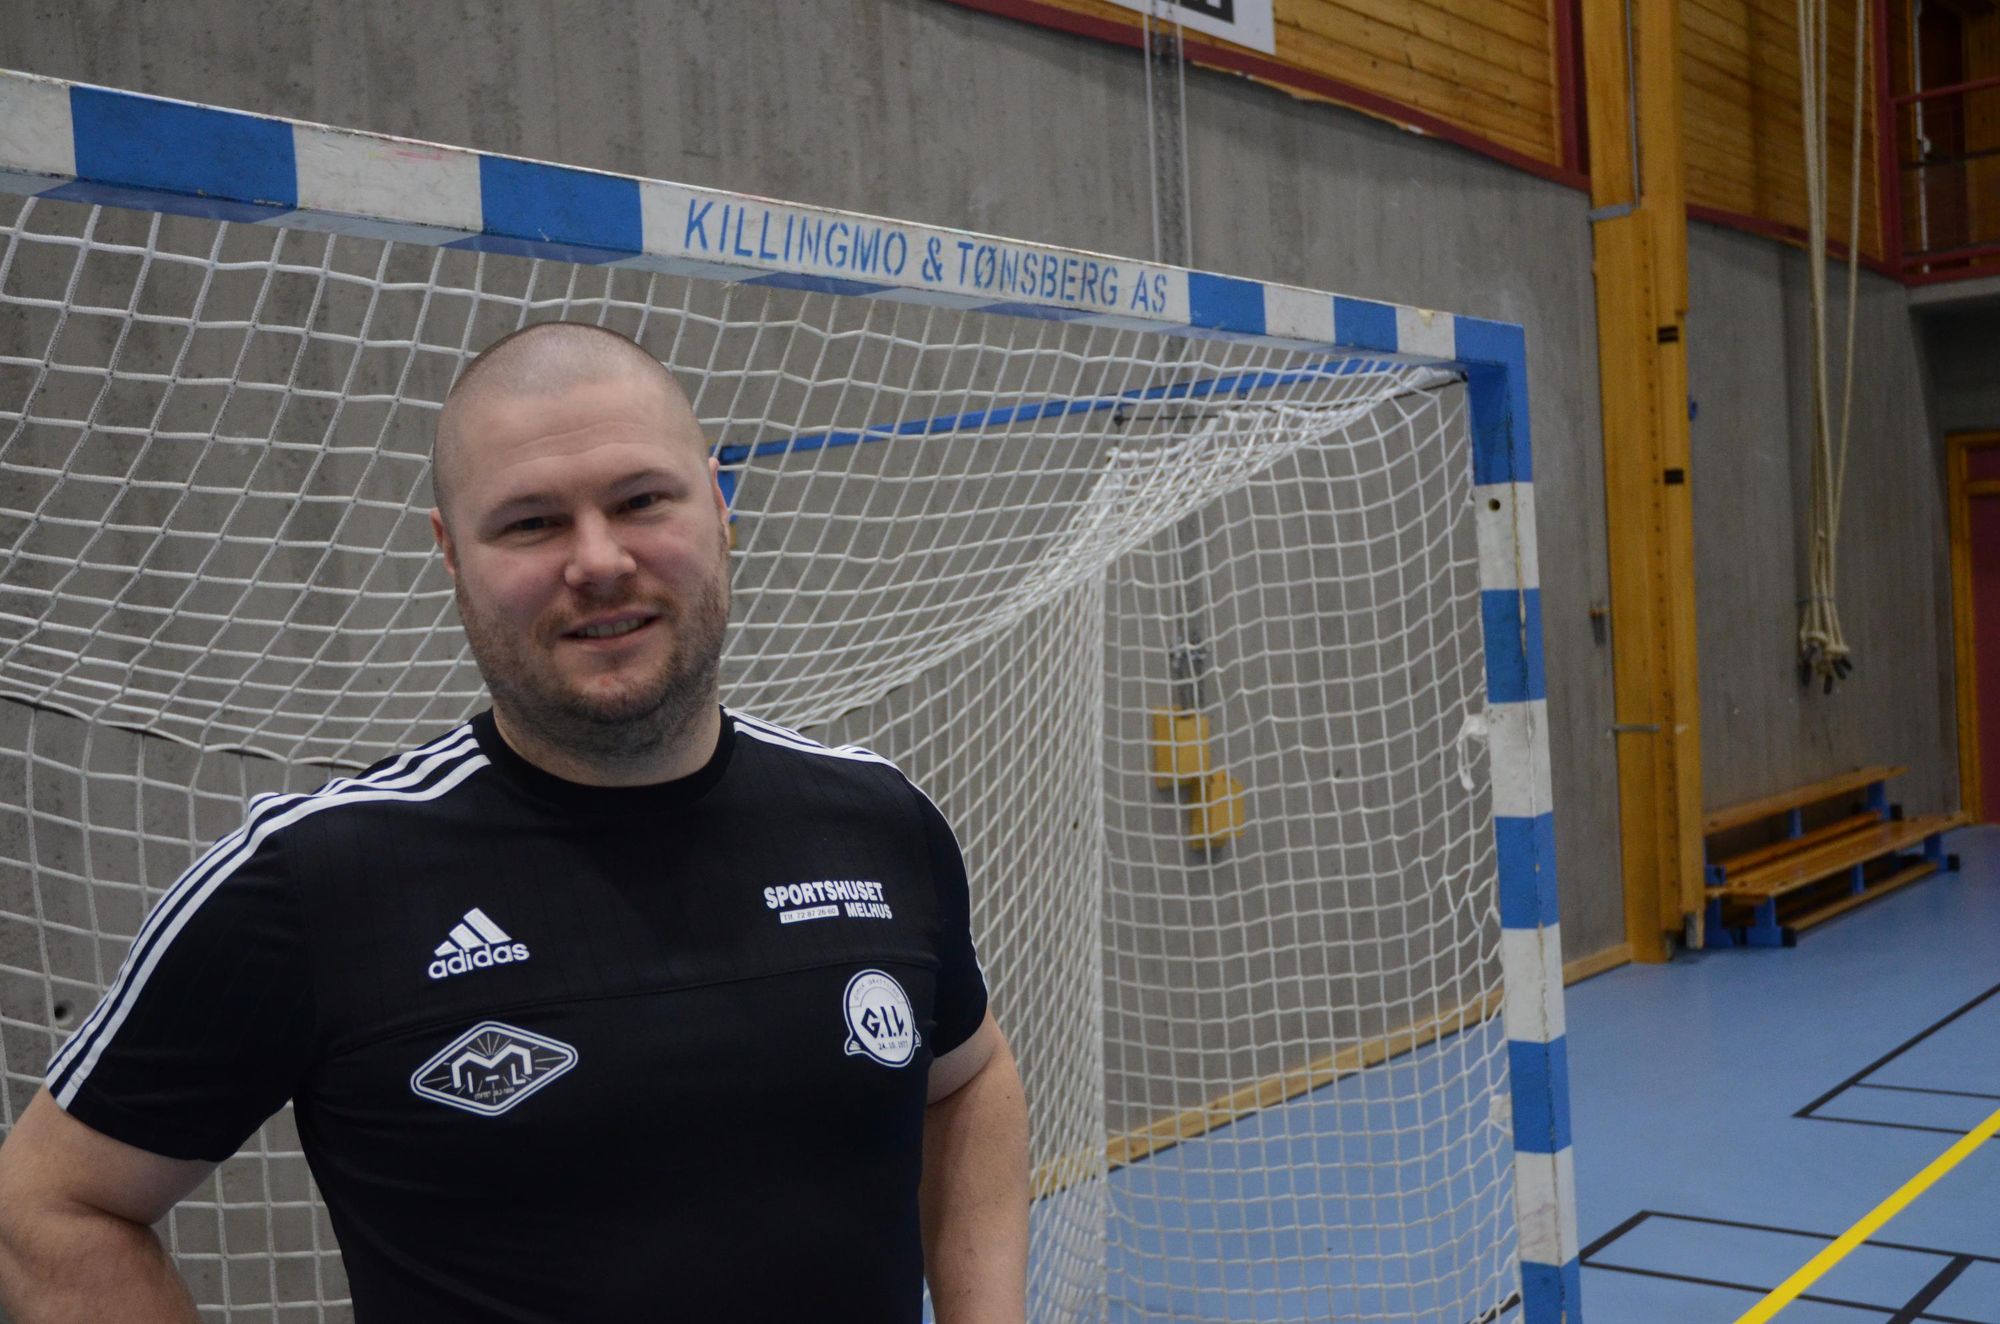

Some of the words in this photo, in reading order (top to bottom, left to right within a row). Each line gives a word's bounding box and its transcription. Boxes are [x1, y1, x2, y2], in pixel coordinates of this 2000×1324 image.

[684, 198, 907, 276] KILLINGMO
[922, 237, 944, 282] &
[958, 240, 1119, 305] TØNSBERG
[1130, 271, 1168, 313] AS
[763, 880, 885, 909] SPORTSHUSET
[844, 902, 893, 920] MELHUS
[428, 943, 530, 979] adidas
